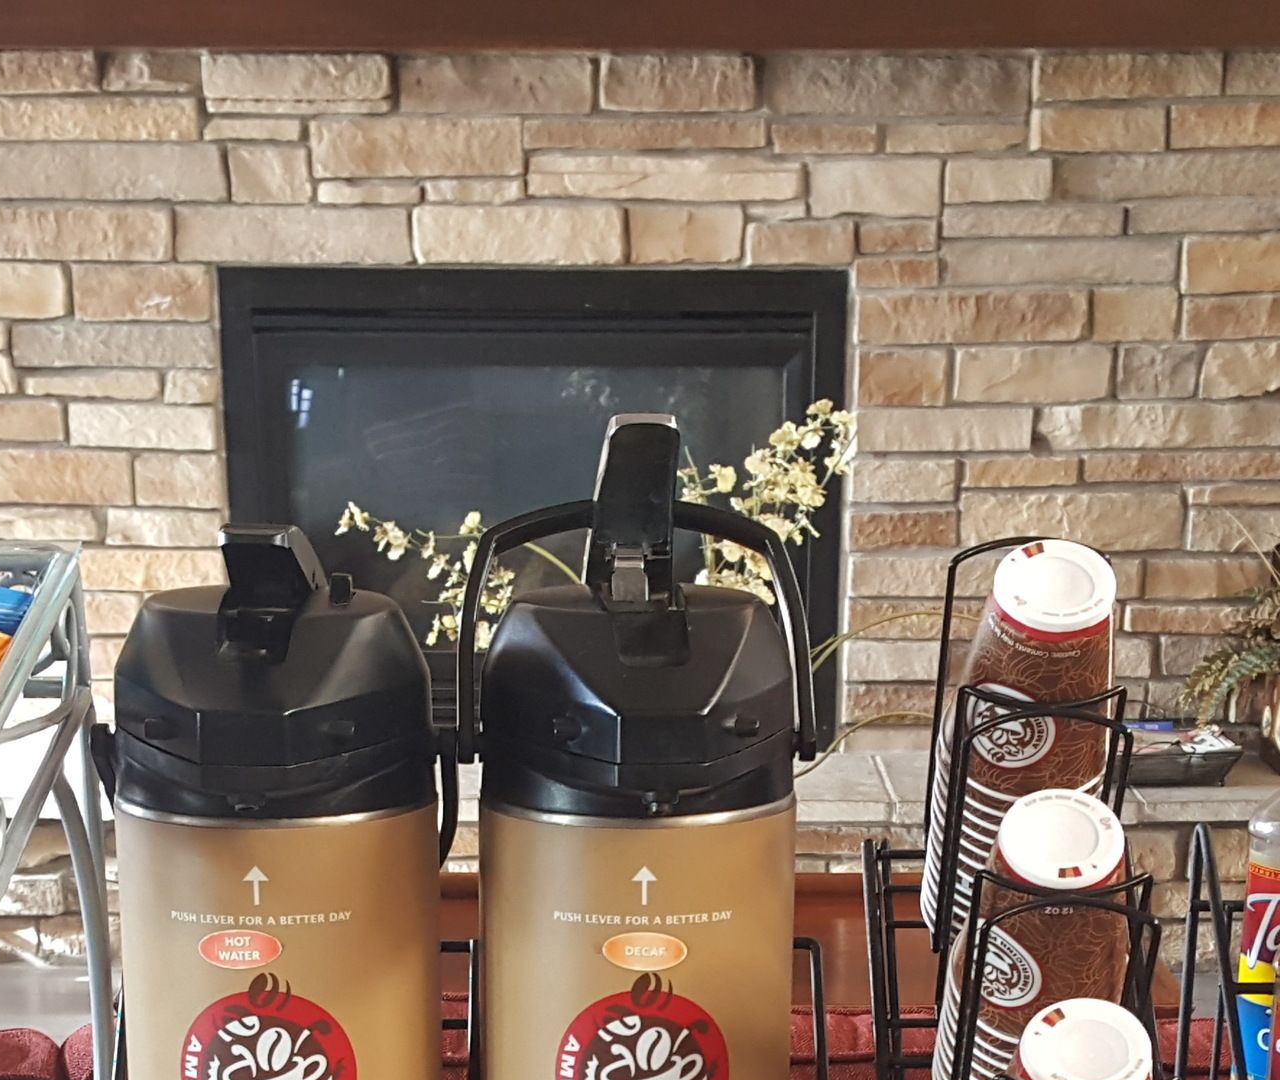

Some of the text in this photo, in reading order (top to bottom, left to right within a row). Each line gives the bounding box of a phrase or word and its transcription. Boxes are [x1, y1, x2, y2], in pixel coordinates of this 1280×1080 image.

[1015, 643, 1049, 658] Contents
[170, 910, 352, 926] PUSH LEVER FOR A BETTER DAY
[553, 910, 733, 926] PUSH LEVER FOR A BETTER DAY
[224, 936, 251, 947] HOT
[218, 950, 261, 961] WATER
[624, 945, 667, 957] DECAF
[1000, 941, 1030, 994] AMERICINN
